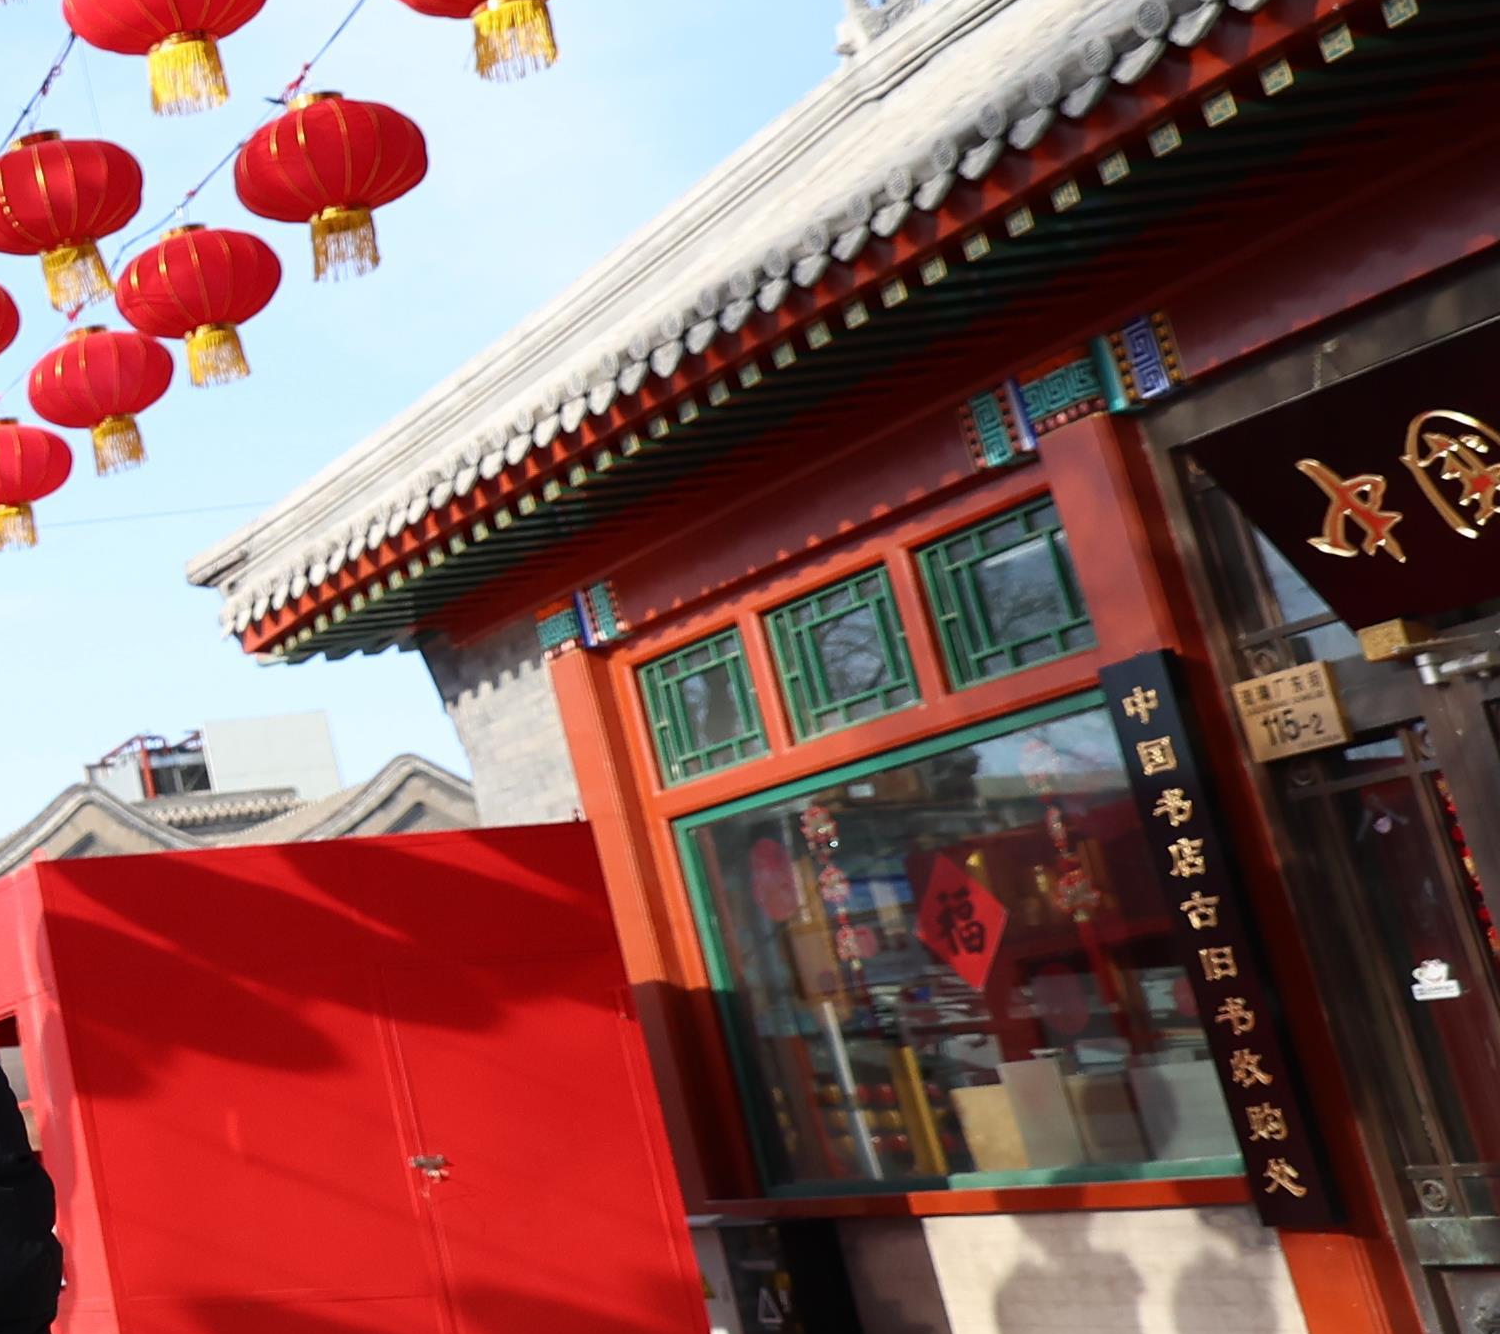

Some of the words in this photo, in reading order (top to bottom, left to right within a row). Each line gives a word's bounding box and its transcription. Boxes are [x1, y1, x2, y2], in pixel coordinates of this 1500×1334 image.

[936, 887, 986, 955] 福
[1121, 685, 1308, 1199] 中国书店古旧书收购处
